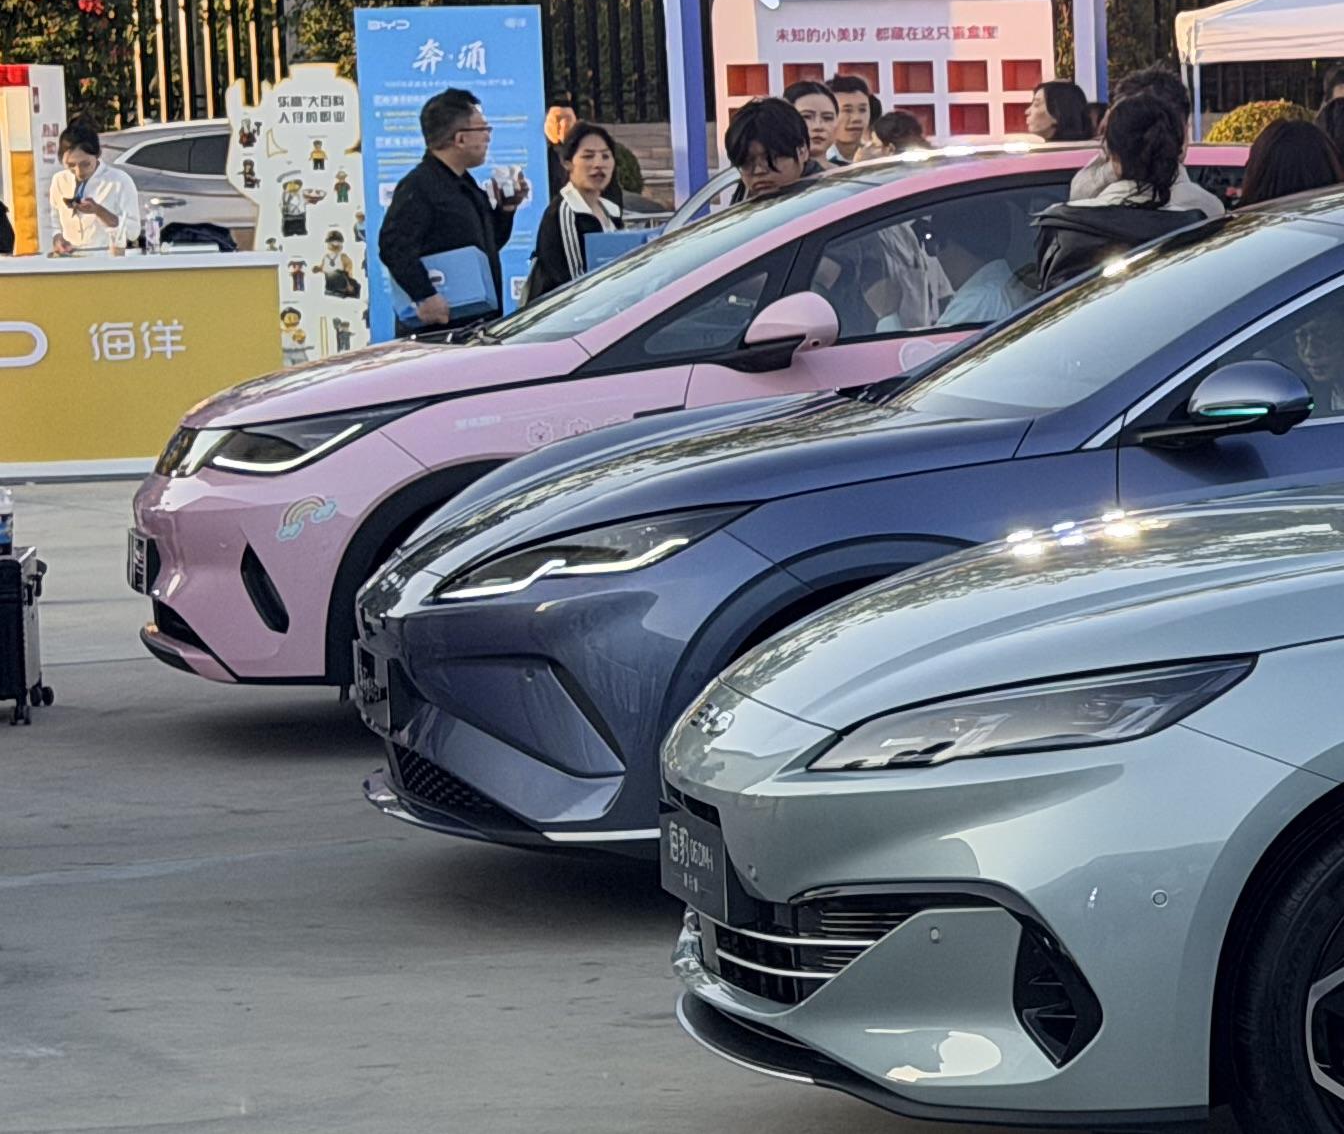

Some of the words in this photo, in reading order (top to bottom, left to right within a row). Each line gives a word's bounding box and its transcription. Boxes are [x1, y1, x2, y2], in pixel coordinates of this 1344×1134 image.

[776, 28, 866, 43] 未知的小美好
[89, 319, 186, 361] 海洋
